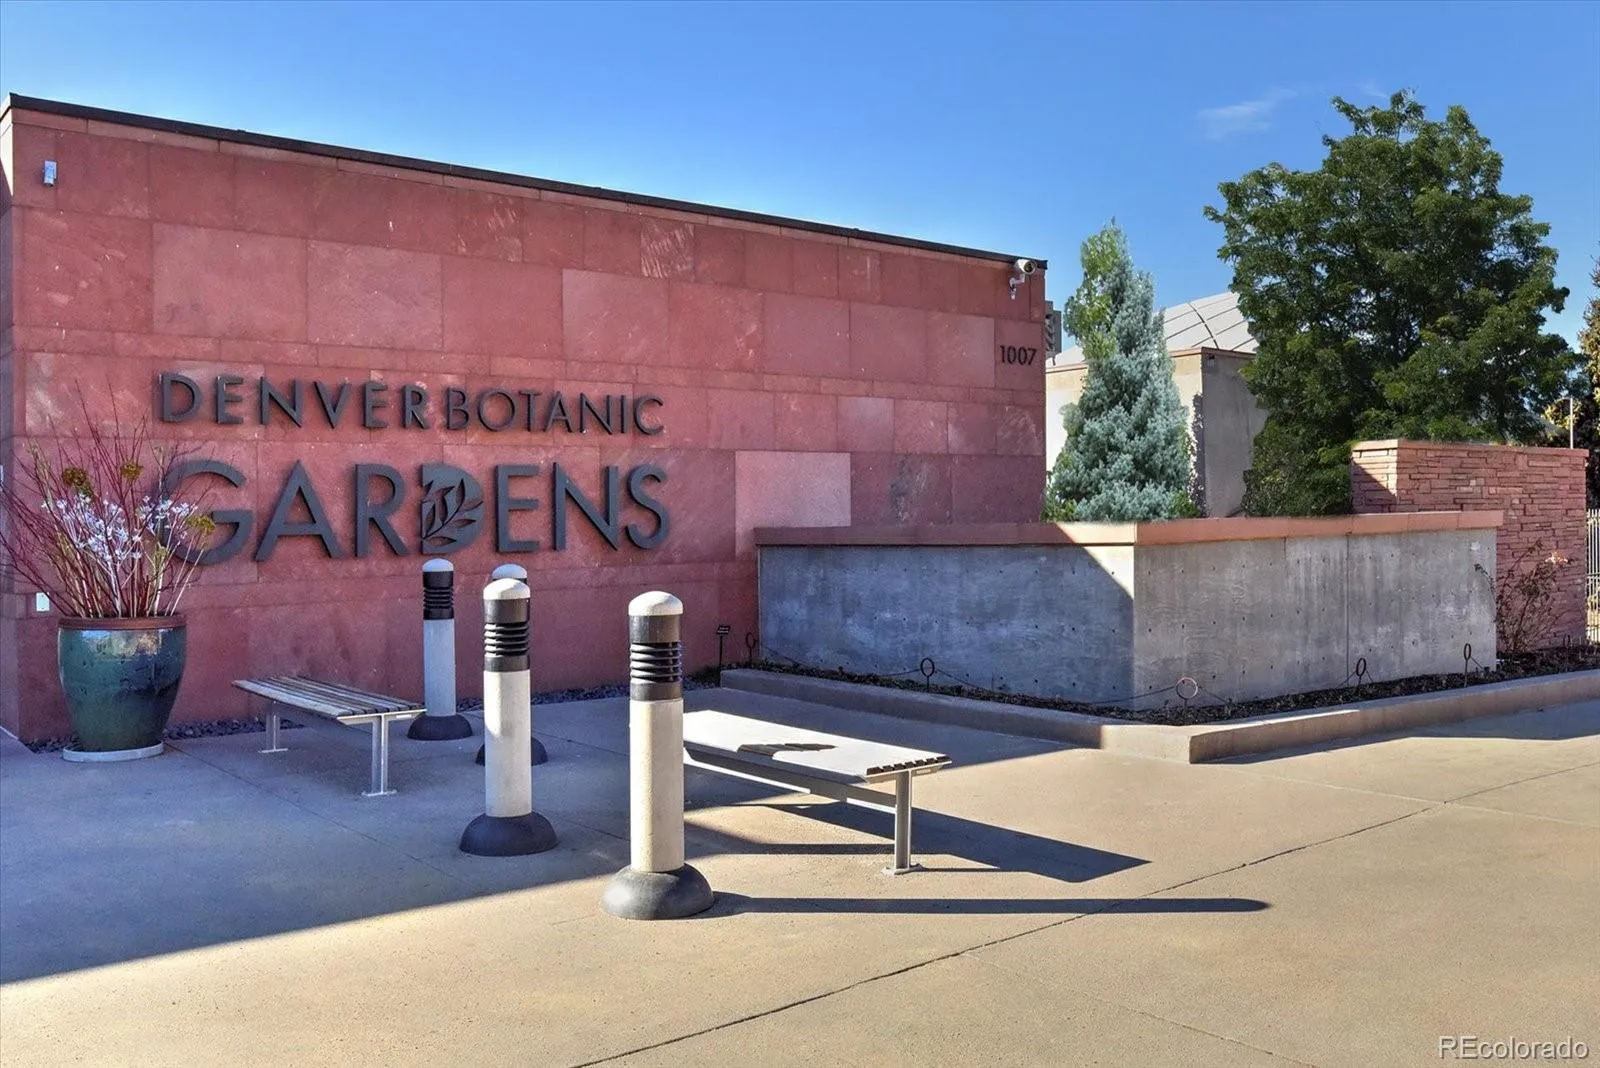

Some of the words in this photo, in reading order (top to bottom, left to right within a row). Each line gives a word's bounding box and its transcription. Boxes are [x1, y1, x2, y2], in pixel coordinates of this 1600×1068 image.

[1000, 344, 1037, 366] 1007
[159, 372, 430, 430] DENVER
[445, 386, 664, 436] BOTANIC
[157, 460, 669, 565] GARDENS
